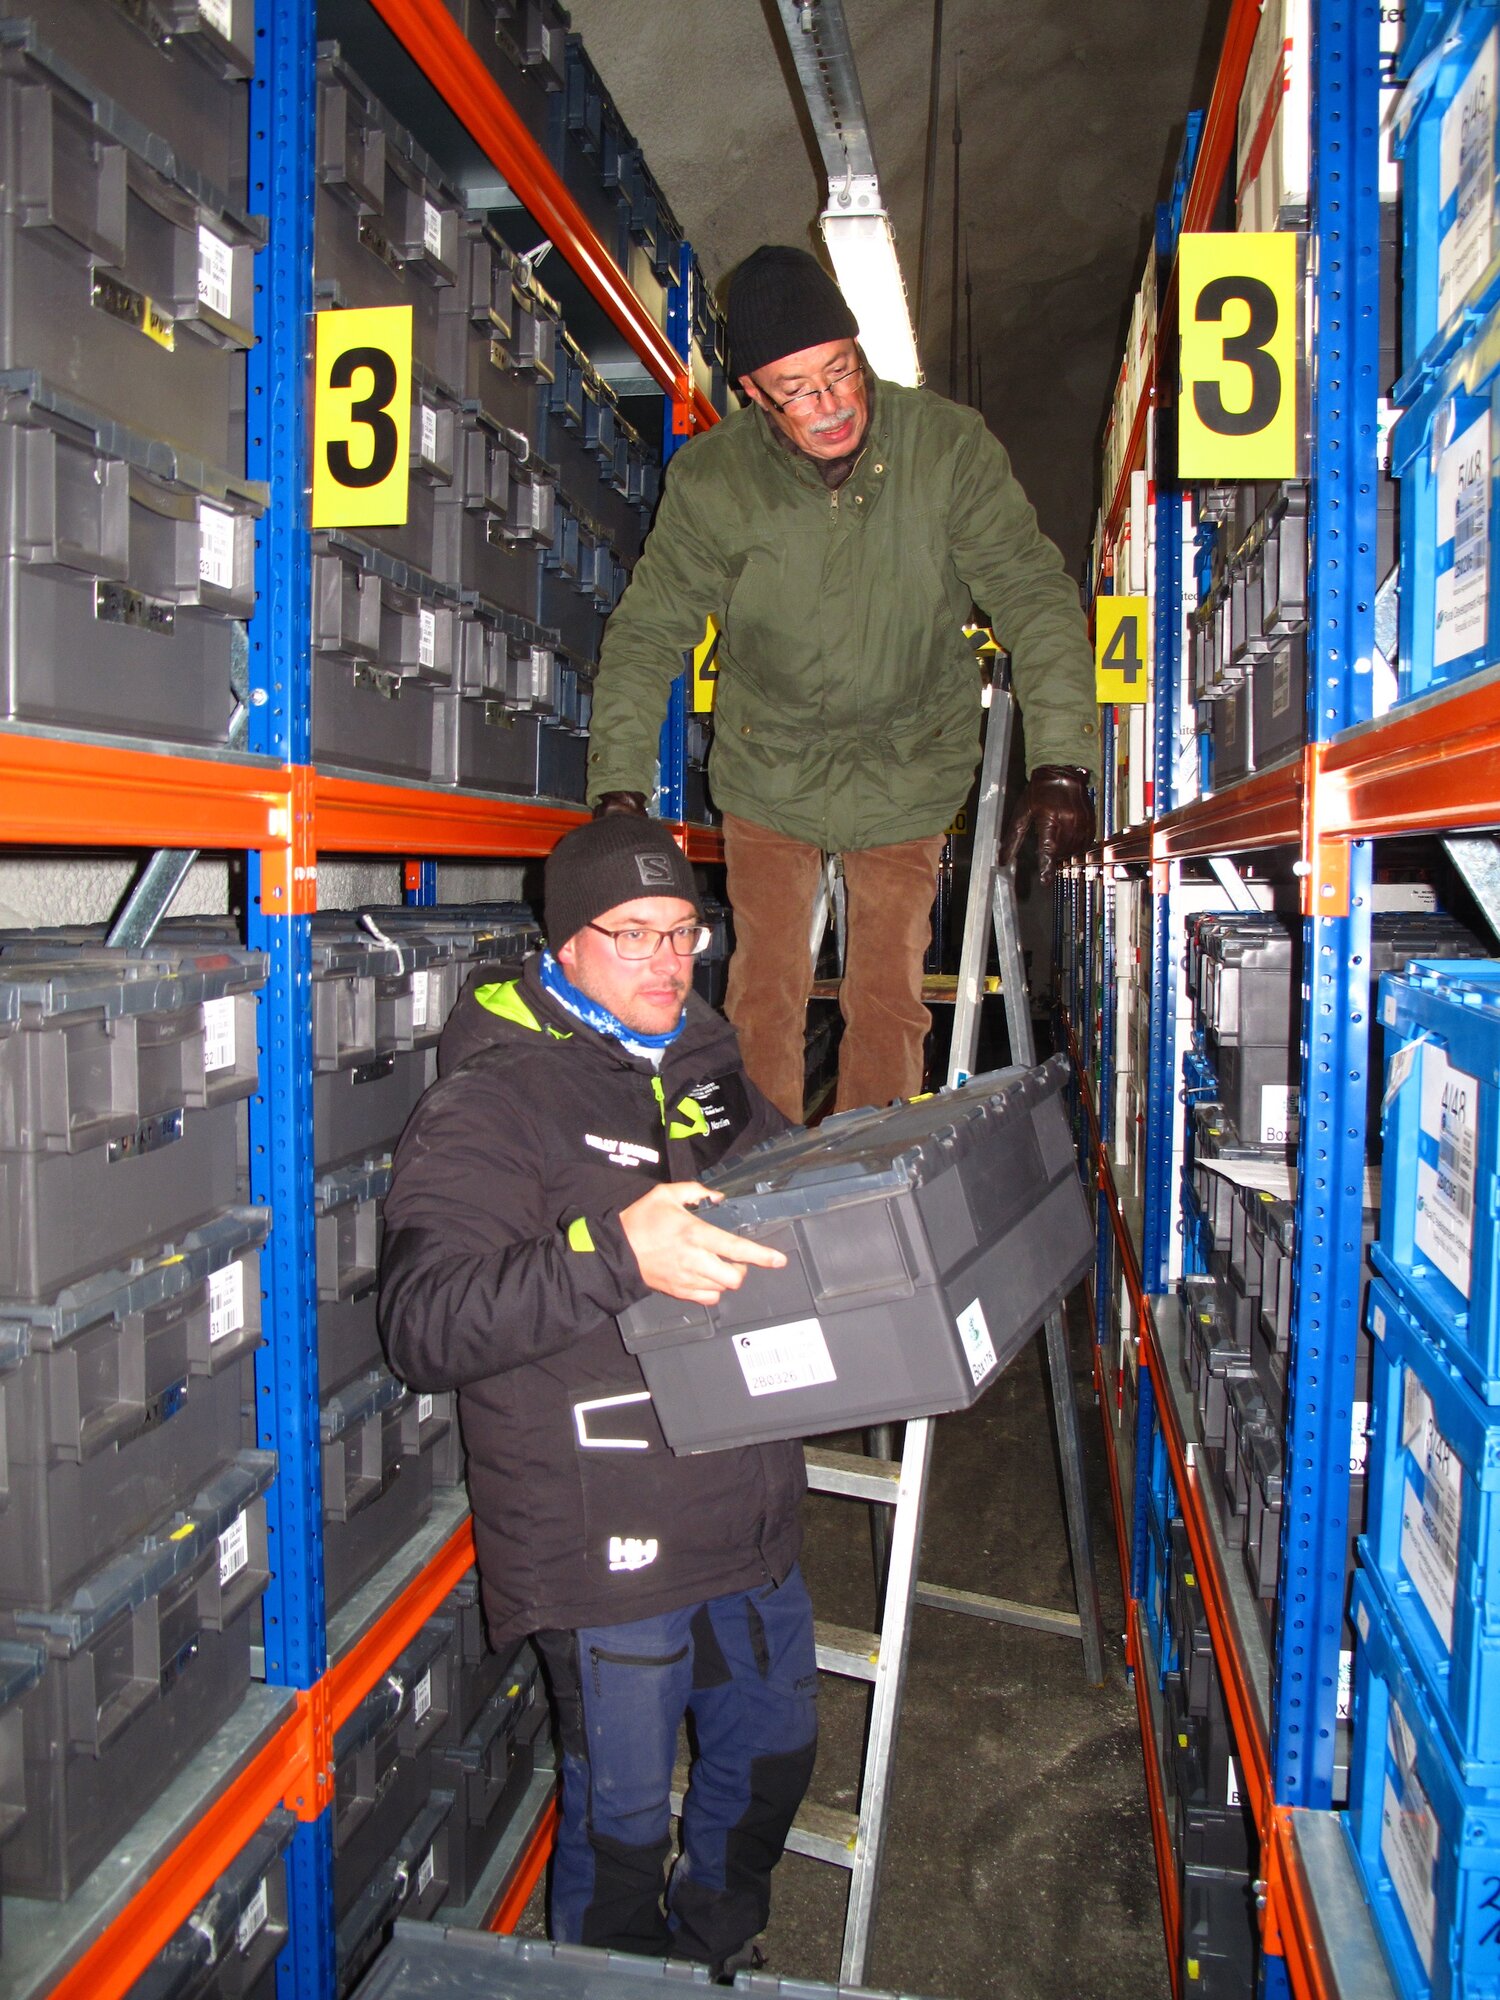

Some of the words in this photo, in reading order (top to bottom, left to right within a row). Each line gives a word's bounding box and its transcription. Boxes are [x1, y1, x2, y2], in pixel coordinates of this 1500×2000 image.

[1192, 275, 1281, 436] 3
[326, 346, 398, 489] 3
[1101, 616, 1143, 684] 4
[1266, 1127, 1291, 1141] Box
[1440, 1081, 1467, 1124] 4/48
